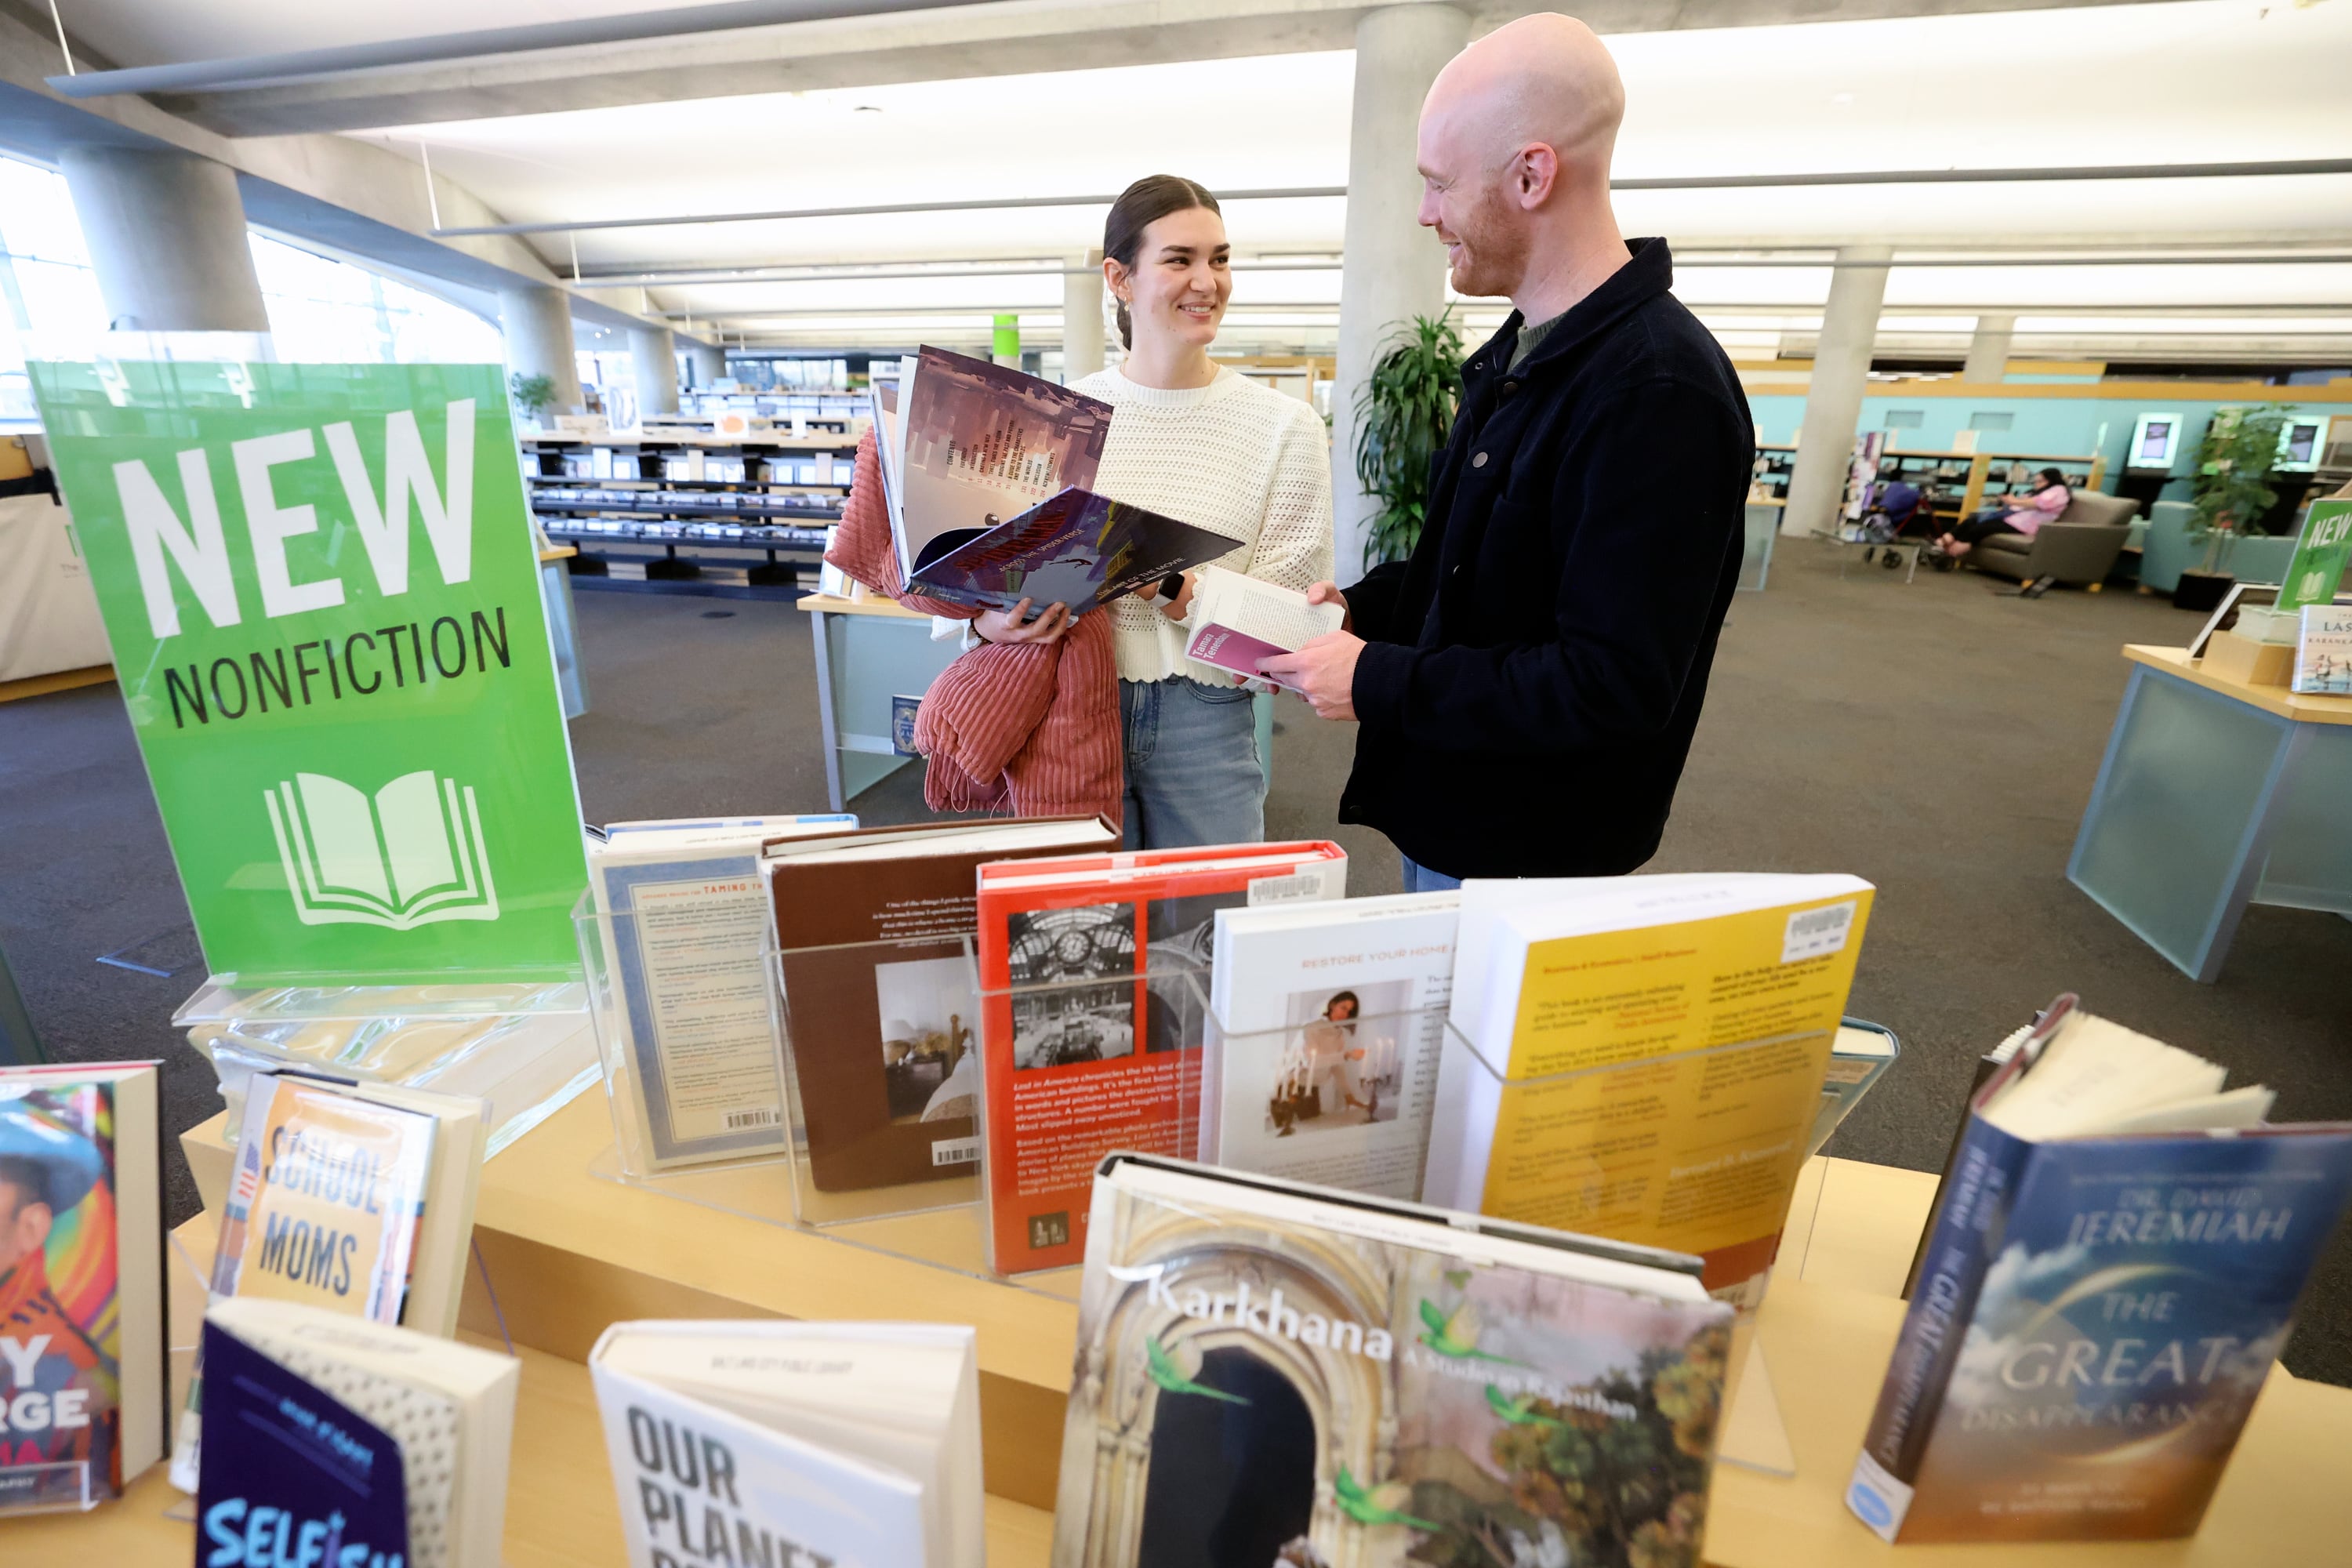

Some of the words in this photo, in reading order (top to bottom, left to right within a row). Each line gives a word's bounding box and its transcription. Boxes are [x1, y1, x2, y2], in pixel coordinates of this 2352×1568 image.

[947, 441, 956, 466] CONTENTS
[1014, 428, 1023, 452] CHARACTERS
[970, 445, 978, 470] INTRODUCTION
[1033, 463, 1043, 485] CONCLUSION
[112, 397, 476, 639] NEW
[2307, 513, 2352, 549] NEW
[1025, 550, 1038, 560] THE
[1156, 557, 1185, 571] MOVIE
[1192, 633, 1214, 656] Tamara
[164, 607, 511, 729] NONFICTION
[704, 883, 747, 895] TAMING
[1301, 953, 1363, 969] RESTORE
[1370, 949, 1407, 962] YOUR
[1410, 944, 1450, 956] HOME
[1014, 1081, 1032, 1092] Lost
[1033, 1080, 1042, 1088] in
[1044, 1076, 1079, 1087] America
[1080, 1069, 1124, 1083] chronicles
[1127, 1067, 1141, 1076] the
[1142, 1065, 1156, 1074] life
[1157, 1062, 1174, 1072] and
[1014, 1090, 1058, 1102] American
[1058, 1083, 1100, 1096] buildings.
[1118, 1078, 1132, 1087] the
[1134, 1076, 1152, 1086] first
[1153, 1073, 1173, 1083] book
[1014, 1102, 1023, 1111] in
[1025, 1100, 1052, 1111] words
[1054, 1098, 1070, 1107] and
[1072, 1093, 1107, 1105] pictures
[1109, 1090, 1123, 1099] the
[1124, 1083, 1173, 1098] destruction
[1015, 1111, 1062, 1122] structures.
[1065, 1107, 1072, 1116] A
[1073, 1104, 1106, 1115] number
[1109, 1100, 1130, 1109] were
[1131, 1095, 1159, 1106] fought
[1016, 1123, 1039, 1132] Most
[1040, 1118, 1072, 1129] slipped
[1074, 1115, 1096, 1125] away
[1098, 1108, 1142, 1121] unnoticed.
[1017, 1138, 1044, 1149] Based
[1058, 1134, 1072, 1142] the
[1074, 1127, 1121, 1140] remarkable
[1123, 1123, 1148, 1134] photo
[1018, 1147, 1058, 1157] American
[1060, 1140, 1100, 1152] Buildings
[266, 1125, 380, 1215] SCHOOL
[1018, 1157, 1046, 1167] stories
[1048, 1155, 1058, 1163] of
[1059, 1151, 1087, 1163] places
[1018, 1168, 1027, 1177] to
[1029, 1166, 1048, 1175] New
[1051, 1162, 1069, 1172] York
[1019, 1186, 1039, 1196] book
[1041, 1182, 1078, 1194] presents
[1063, 1171, 1077, 1180] the
[2067, 1209, 2292, 1244] JEREMIAH
[260, 1211, 358, 1298] MOMS
[1146, 1272, 1393, 1362] Karkhana
[2102, 1292, 2182, 1323] THE
[2001, 1336, 2241, 1391] GREAT
[1403, 1348, 1419, 1367] A
[1426, 1352, 1491, 1381] Studio
[1526, 1374, 1638, 1423] Rajasthan
[0, 1388, 91, 1433] GE
[626, 1404, 742, 1508] OUR
[203, 1496, 405, 1568] SELFI
